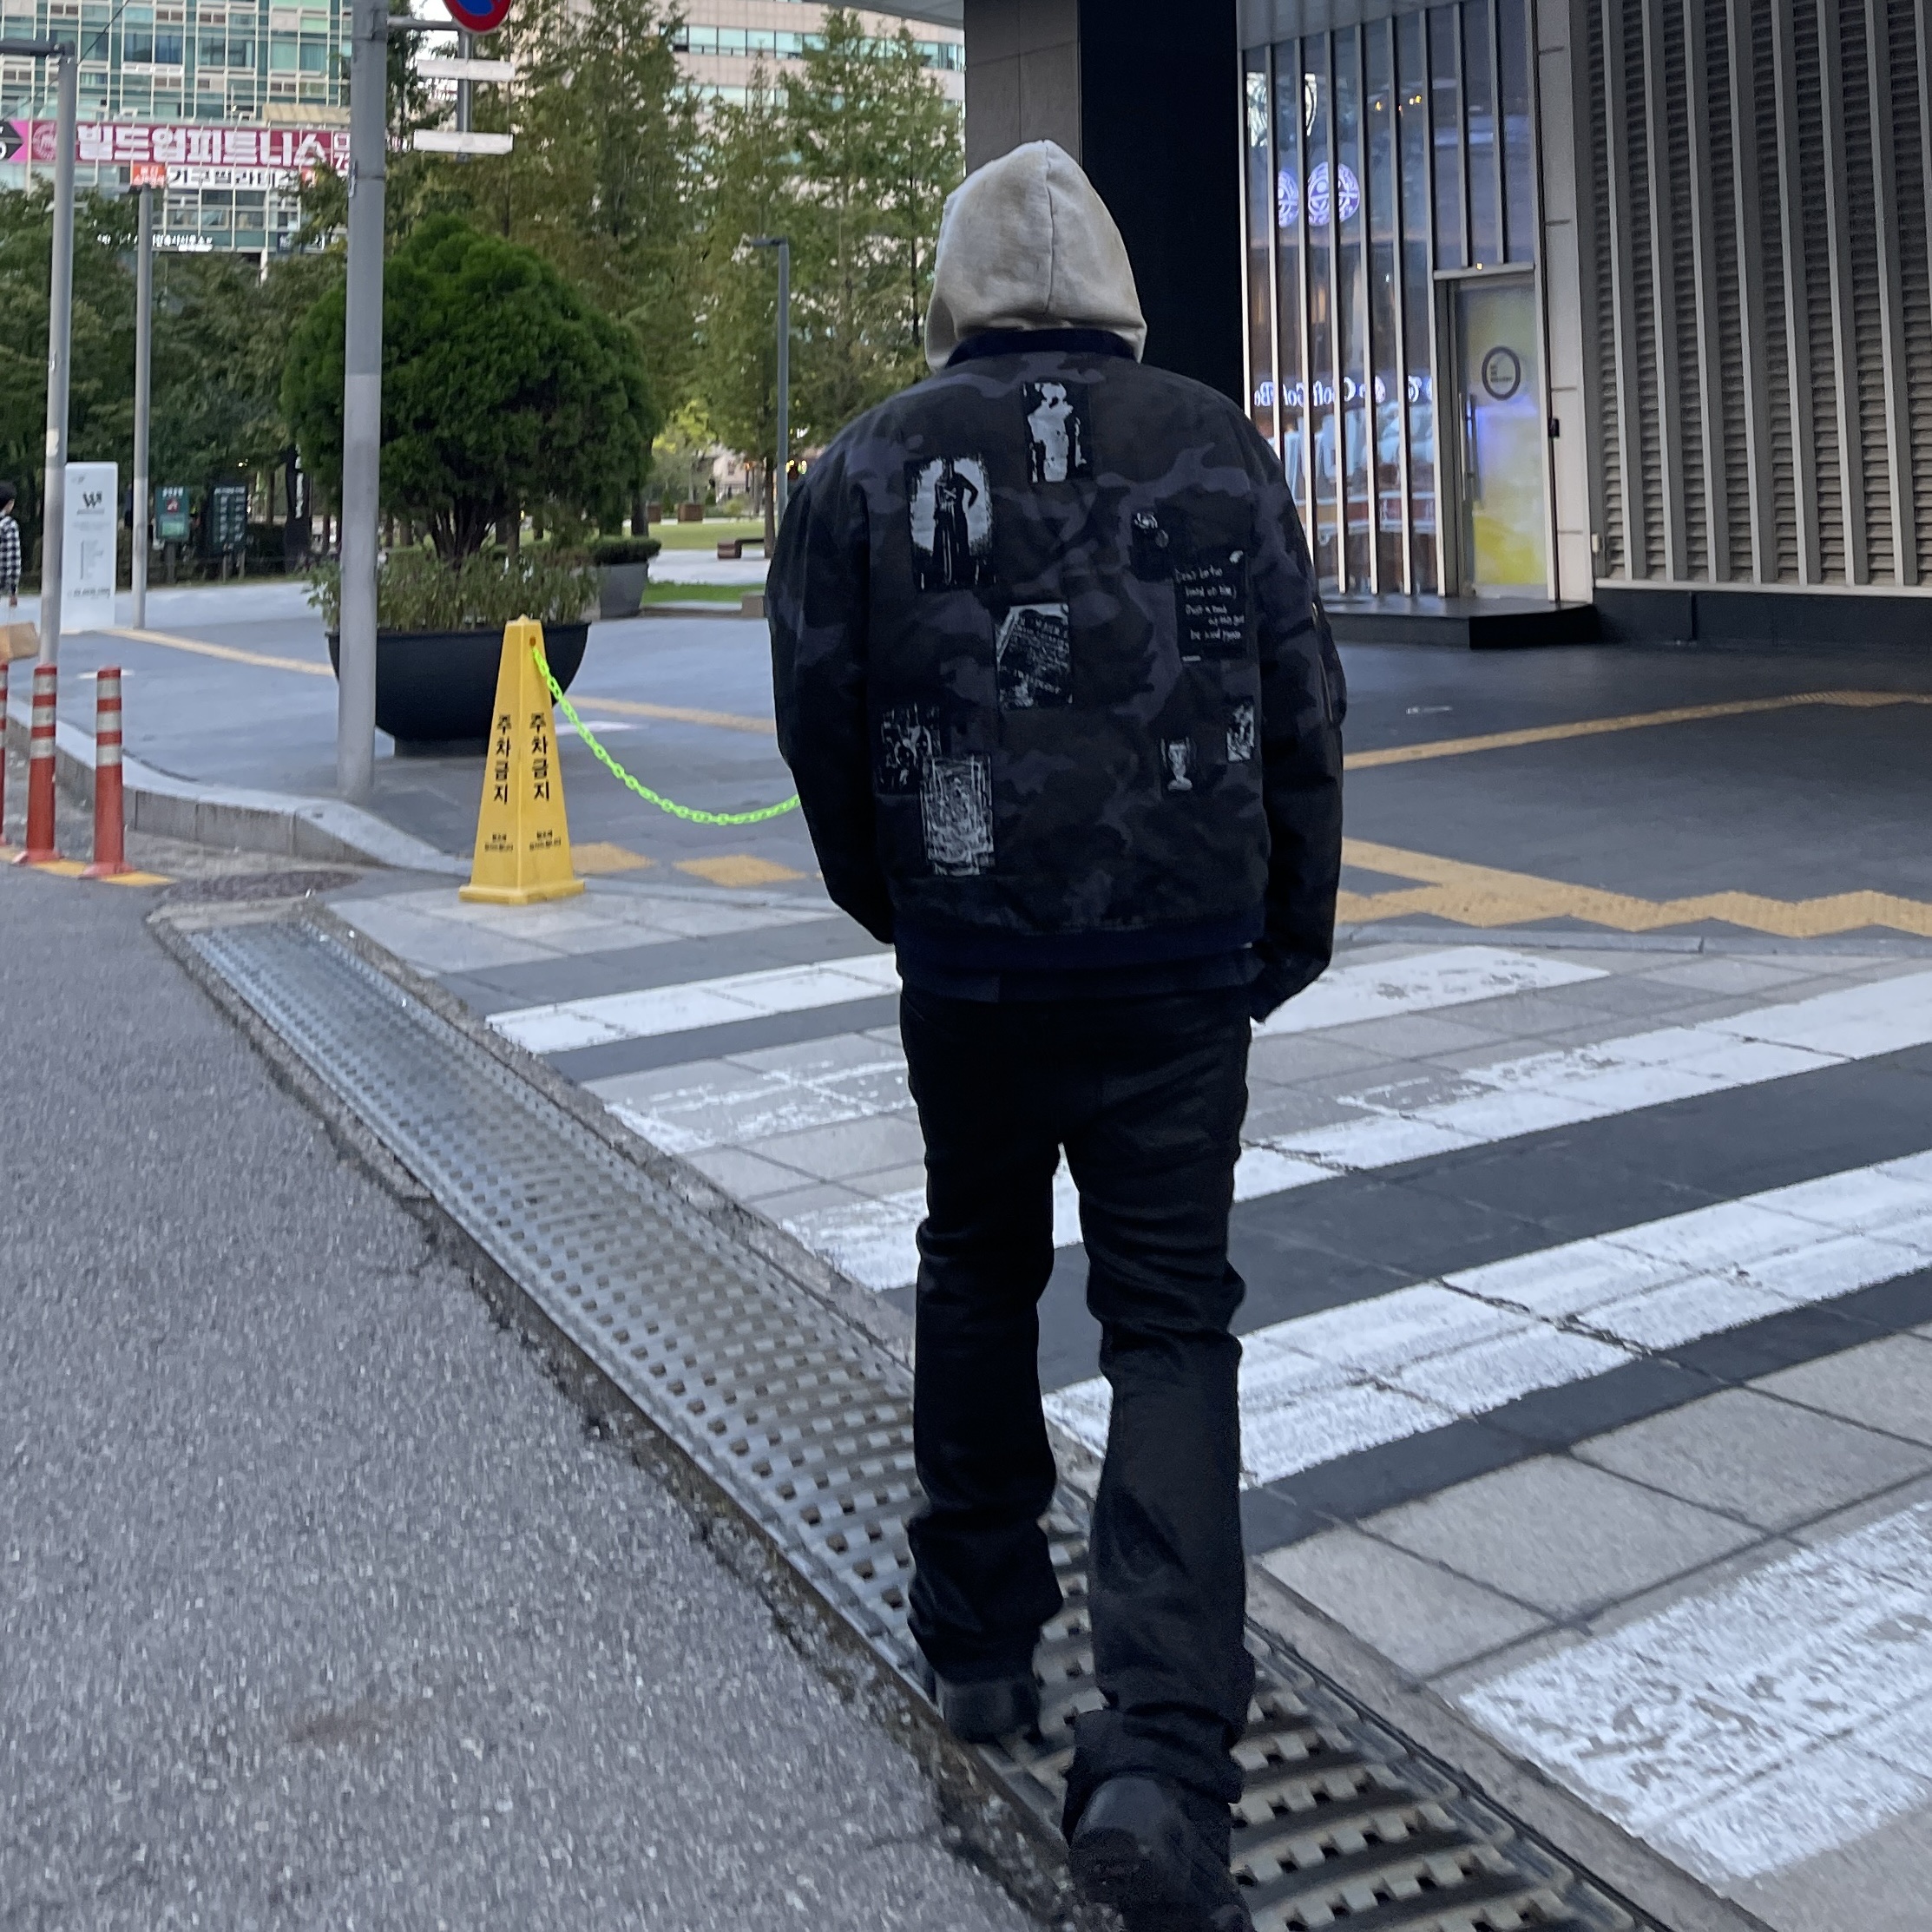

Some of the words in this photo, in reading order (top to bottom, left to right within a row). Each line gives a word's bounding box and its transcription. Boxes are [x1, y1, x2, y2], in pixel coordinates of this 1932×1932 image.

[77, 124, 326, 168] 빌드업피트니스
[494, 713, 512, 805] 주차금지
[529, 712, 550, 802] 주차금지
